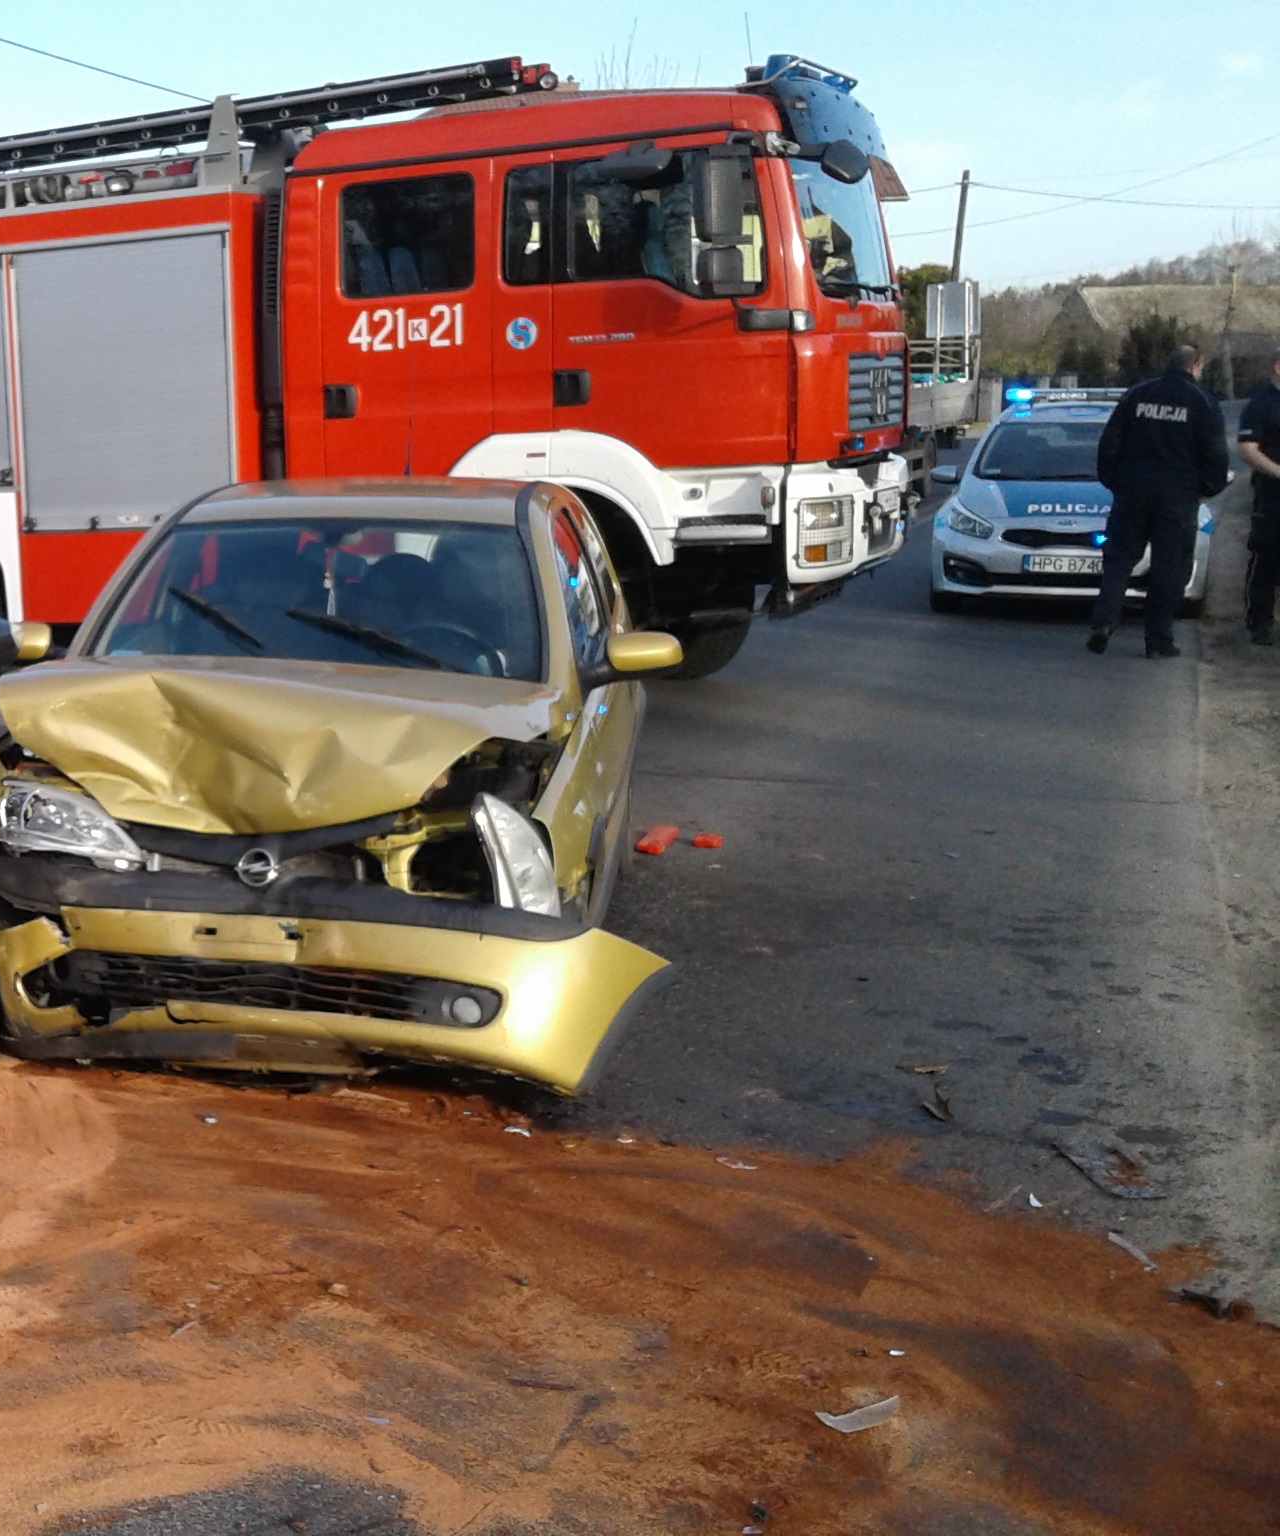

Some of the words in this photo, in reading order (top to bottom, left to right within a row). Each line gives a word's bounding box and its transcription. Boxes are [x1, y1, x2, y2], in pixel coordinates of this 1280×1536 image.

[1136, 403, 1188, 423] POLICJA
[1027, 503, 1111, 514] POLICJA
[1032, 557, 1064, 571] HPG
